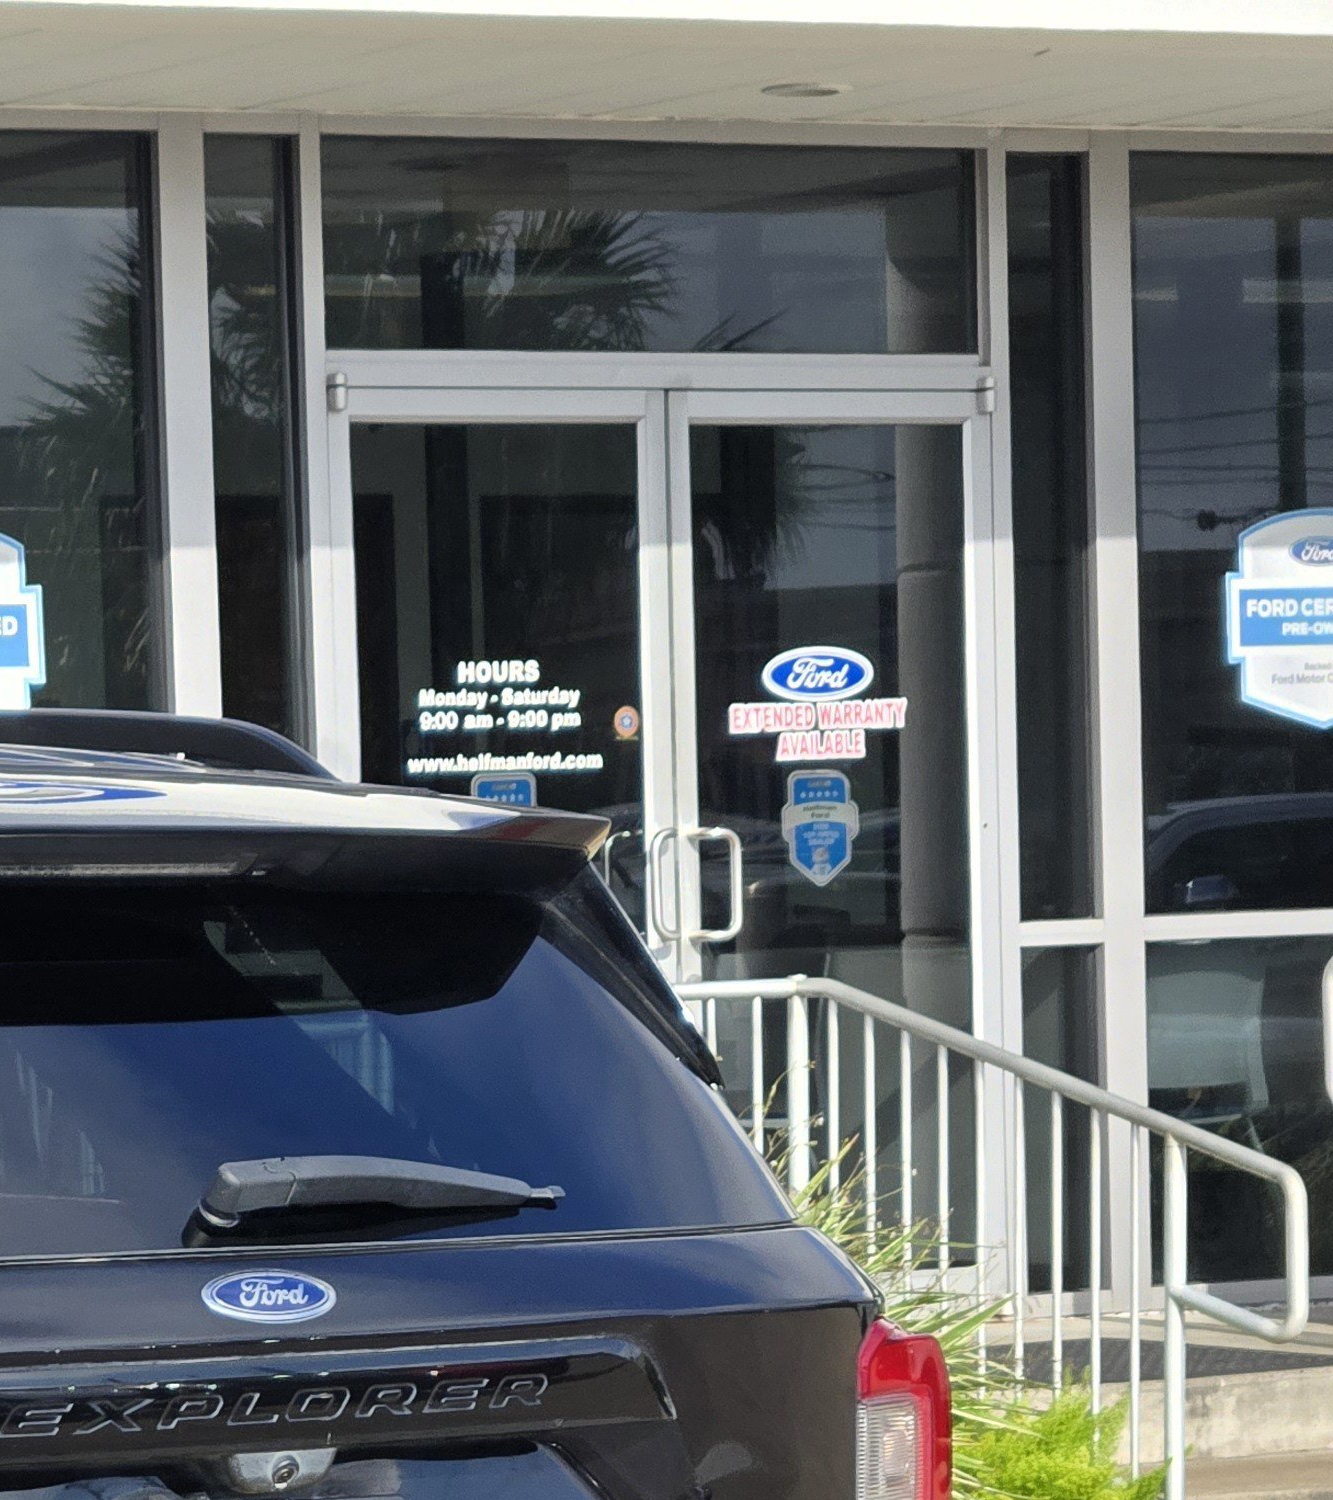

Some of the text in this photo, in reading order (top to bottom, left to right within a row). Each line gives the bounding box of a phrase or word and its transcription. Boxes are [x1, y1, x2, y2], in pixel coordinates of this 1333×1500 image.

[1246, 598, 1298, 617] FORD
[456, 659, 540, 684] HOURS
[787, 657, 850, 689] Ford
[418, 688, 488, 710] Monday
[501, 686, 581, 708] Saturday
[419, 710, 459, 732] 9:00
[464, 713, 494, 729] am
[507, 709, 549, 729] 9:00
[551, 710, 582, 732] pm
[733, 700, 906, 730] EXTENDED WARRANTY
[781, 732, 864, 756] AVAILABLE
[407, 751, 604, 773] www.helfmanford.com
[239, 1277, 309, 1307] Ford
